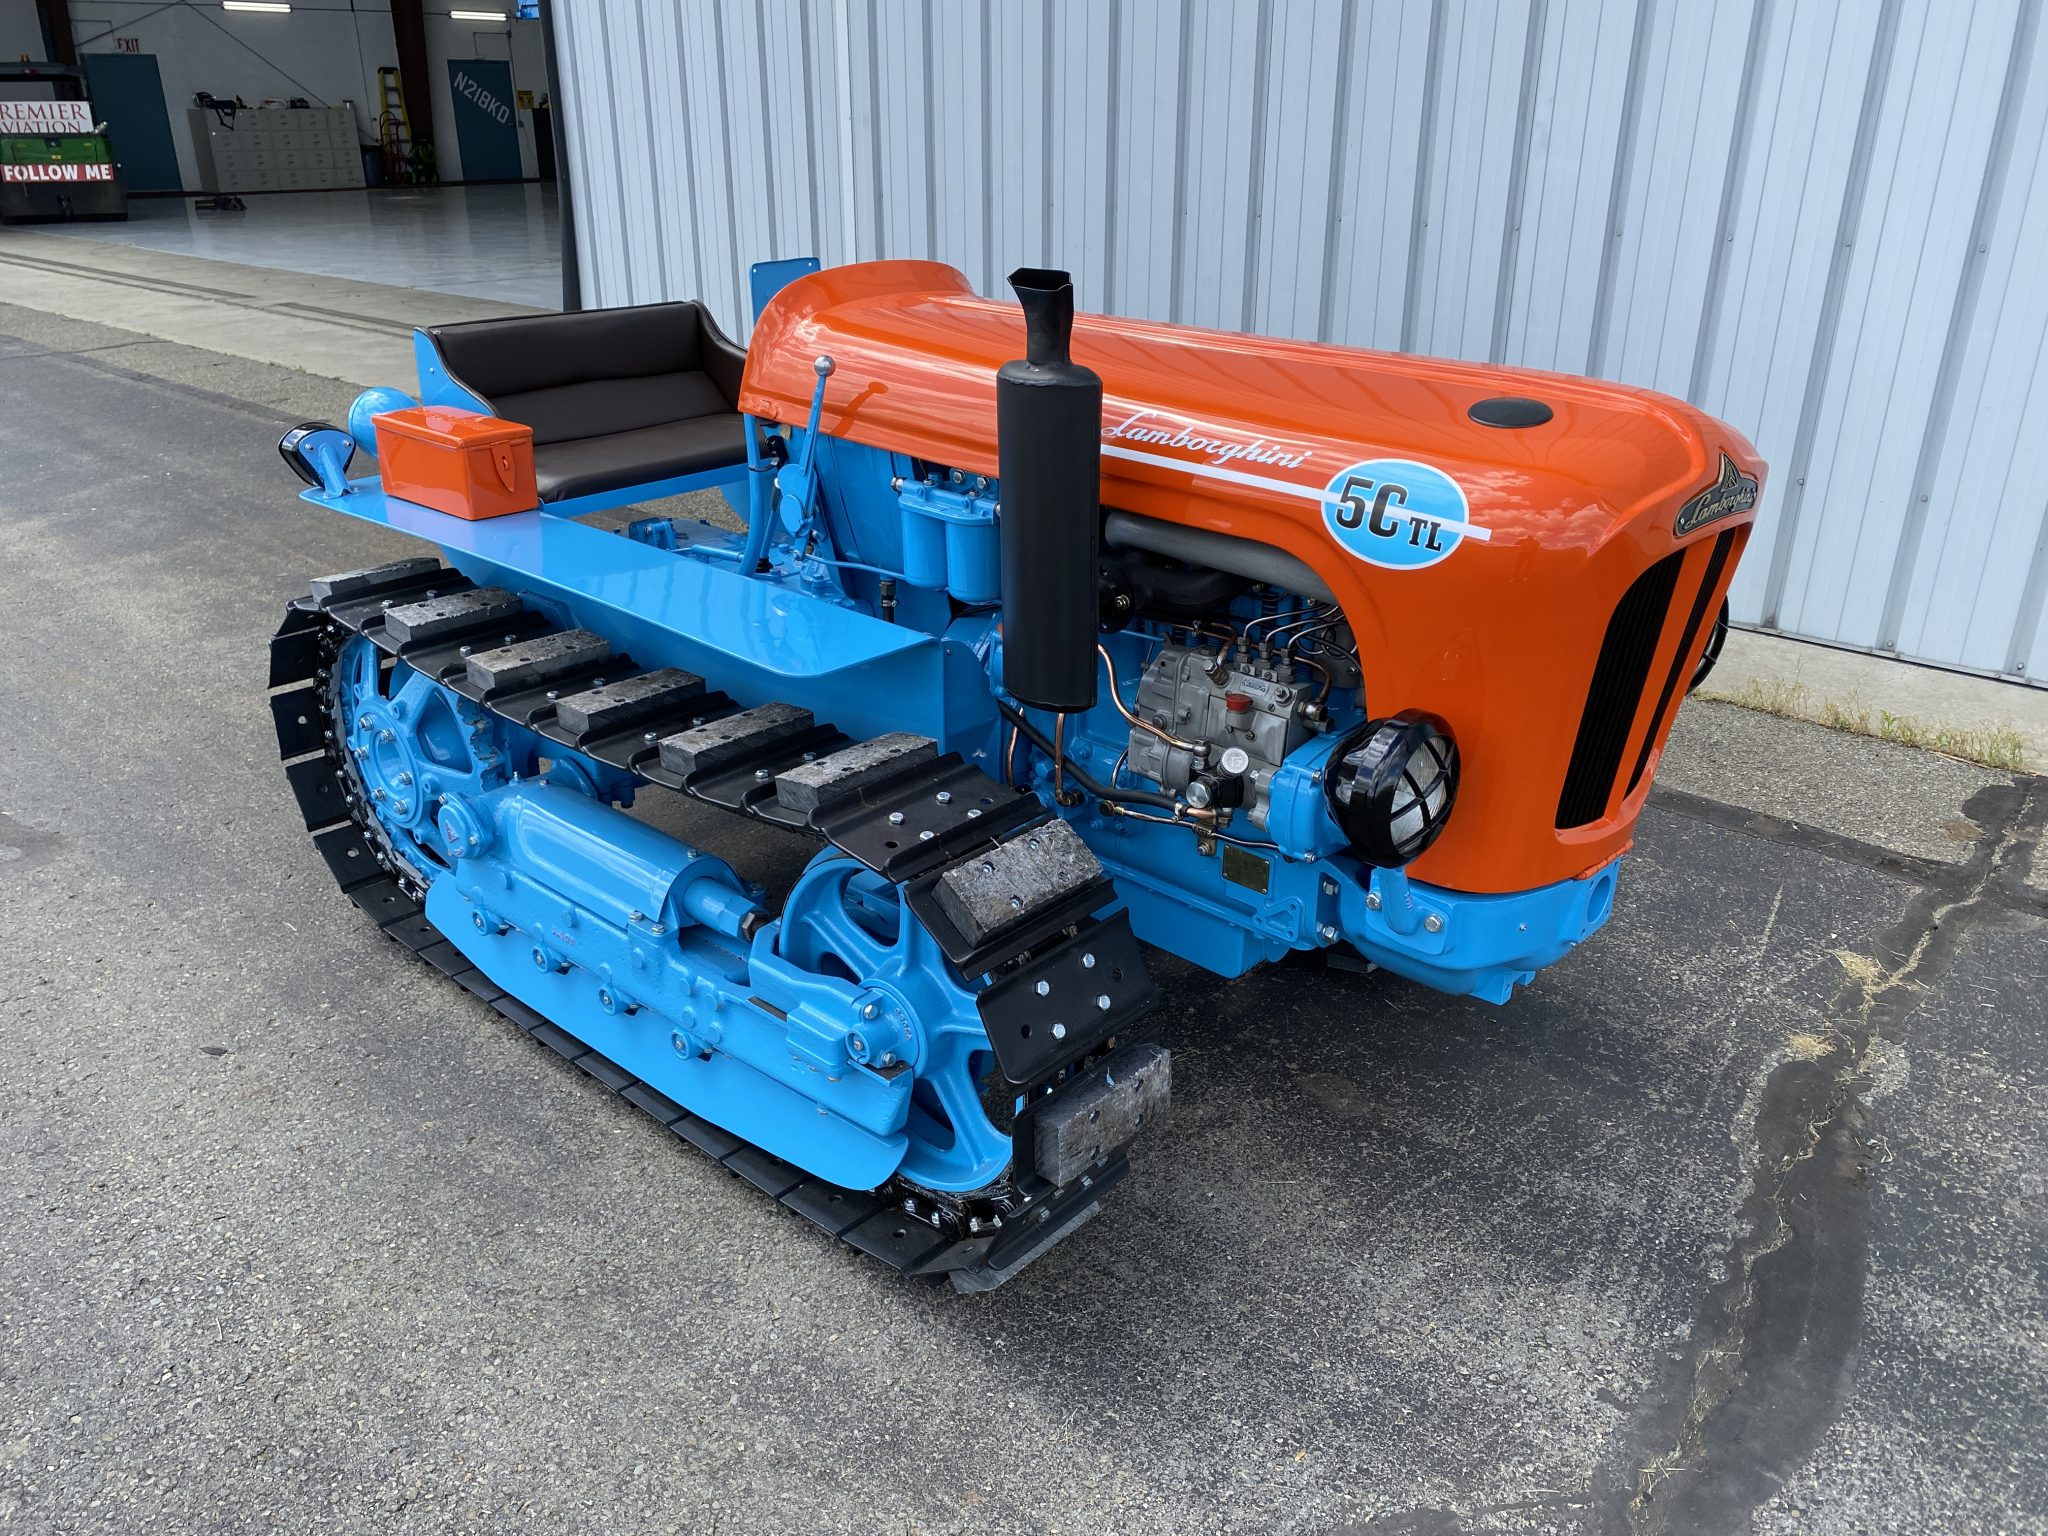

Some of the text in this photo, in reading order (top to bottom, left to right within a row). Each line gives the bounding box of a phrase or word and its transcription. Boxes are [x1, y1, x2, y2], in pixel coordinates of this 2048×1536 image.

[117, 38, 139, 53] EXIT
[0, 120, 81, 133] VIATION
[4, 164, 111, 181] FOLLOW ME
[1101, 411, 1312, 469] Lamborghini
[1336, 475, 1443, 553] 5C TL
